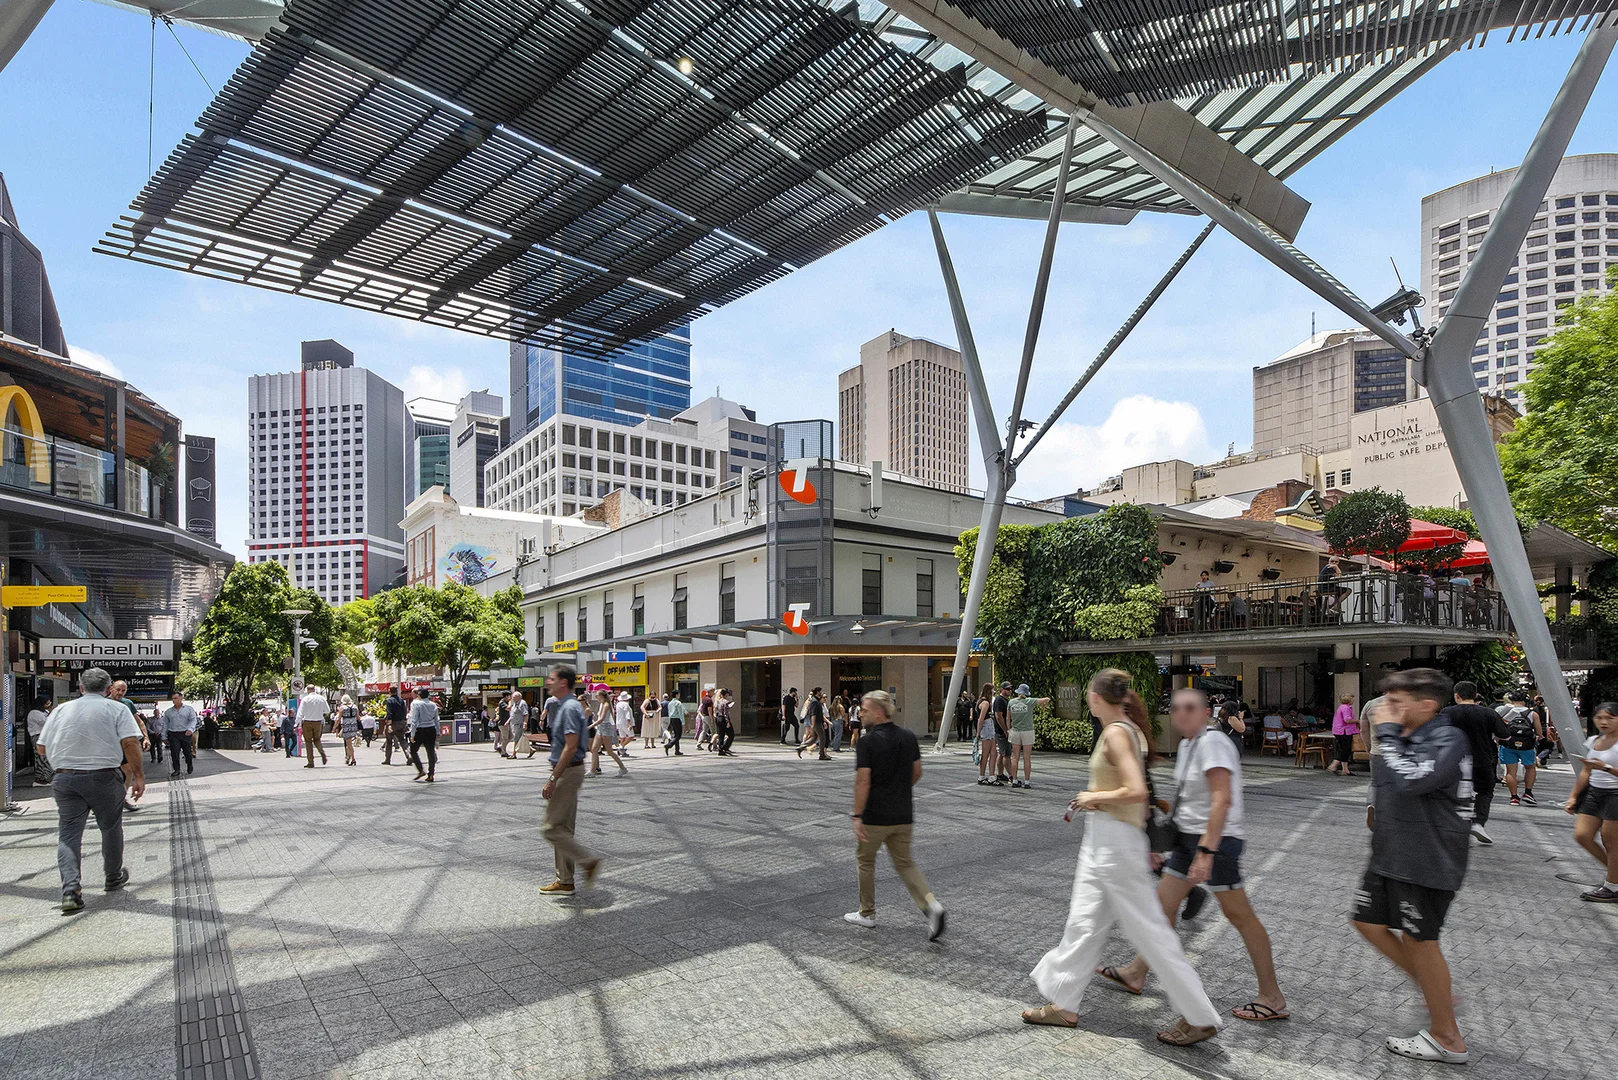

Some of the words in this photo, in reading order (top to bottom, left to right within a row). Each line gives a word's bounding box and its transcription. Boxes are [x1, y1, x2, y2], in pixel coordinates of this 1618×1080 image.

[1358, 424, 1422, 444] NATIONAL
[1425, 429, 1443, 437] LIMIT
[1364, 451, 1395, 464] PUBLIC
[1399, 446, 1421, 457] SAFE
[1425, 441, 1448, 452] DEPO
[53, 643, 132, 655] michael
[138, 643, 162, 655] hill
[90, 660, 120, 668] Kentucky
[120, 660, 138, 668] Fried
[138, 660, 164, 668] Chicken
[607, 666, 618, 675] OFF
[626, 664, 641, 673] TREE
